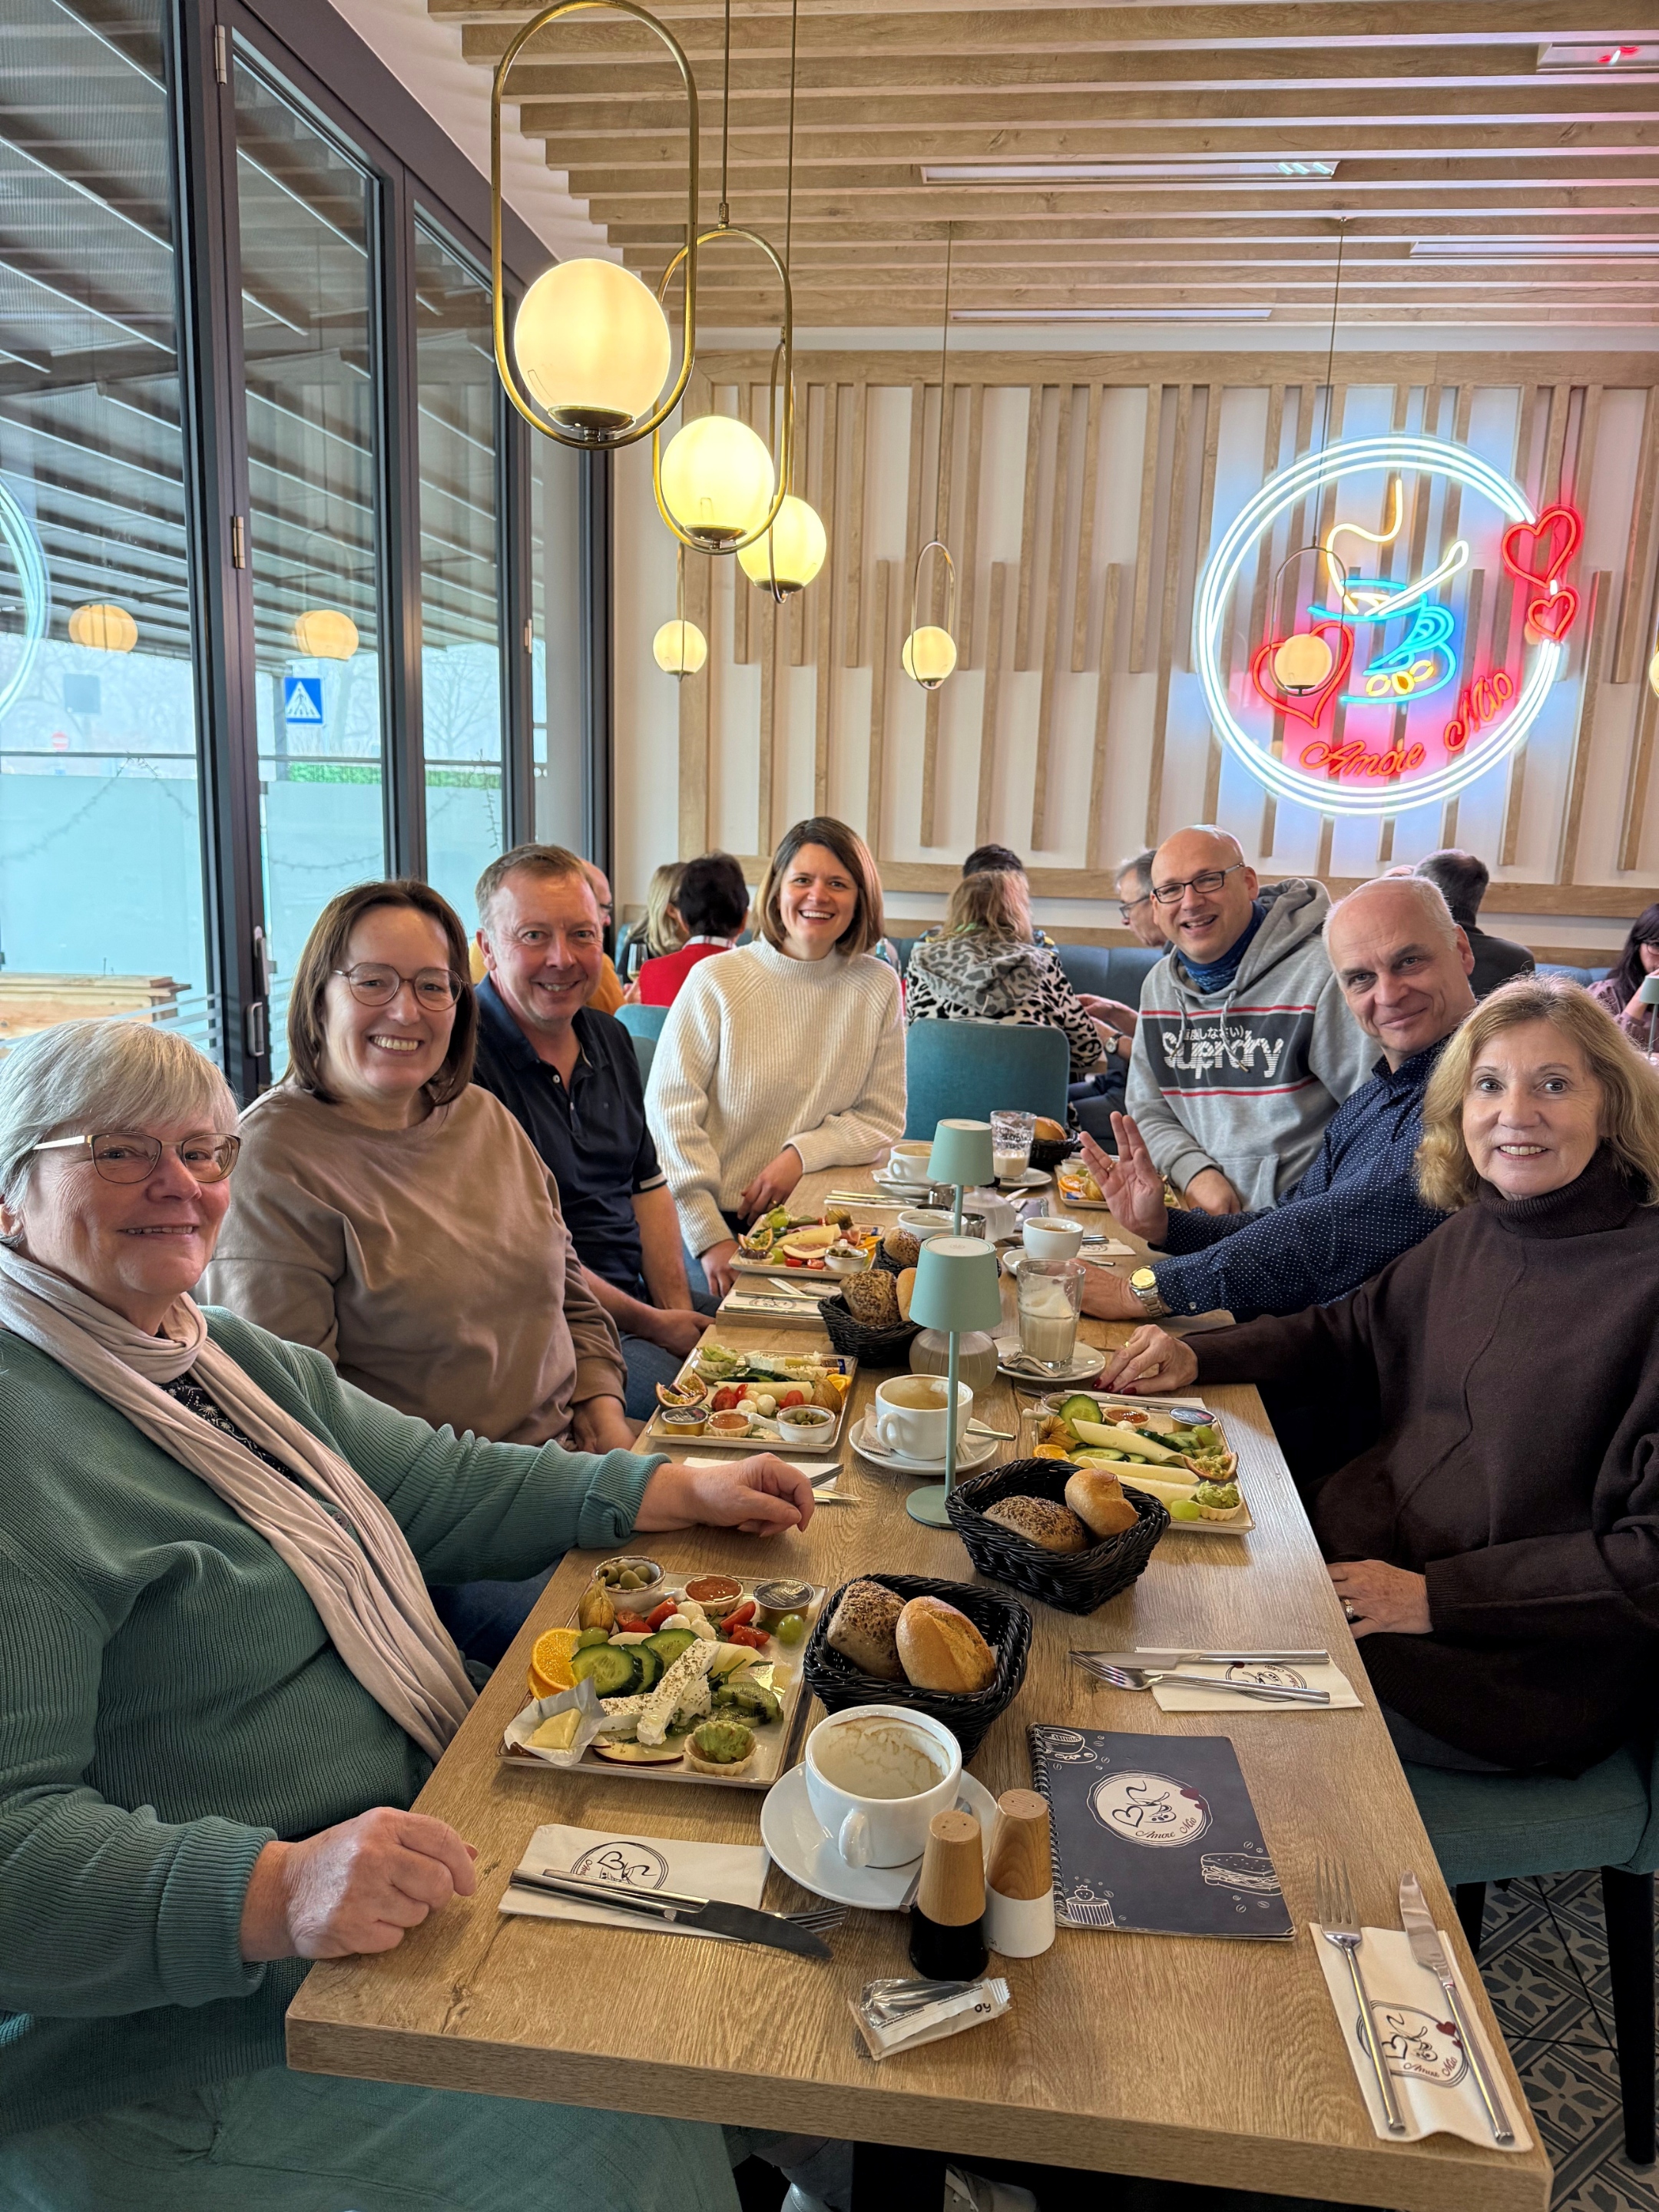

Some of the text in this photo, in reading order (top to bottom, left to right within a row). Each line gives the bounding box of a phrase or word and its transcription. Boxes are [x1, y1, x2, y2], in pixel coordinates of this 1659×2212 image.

[1300, 672, 1513, 777] Amore Mio
[1162, 1030, 1284, 1079] Superdry
[1135, 1817, 1197, 1839] Amore Mio
